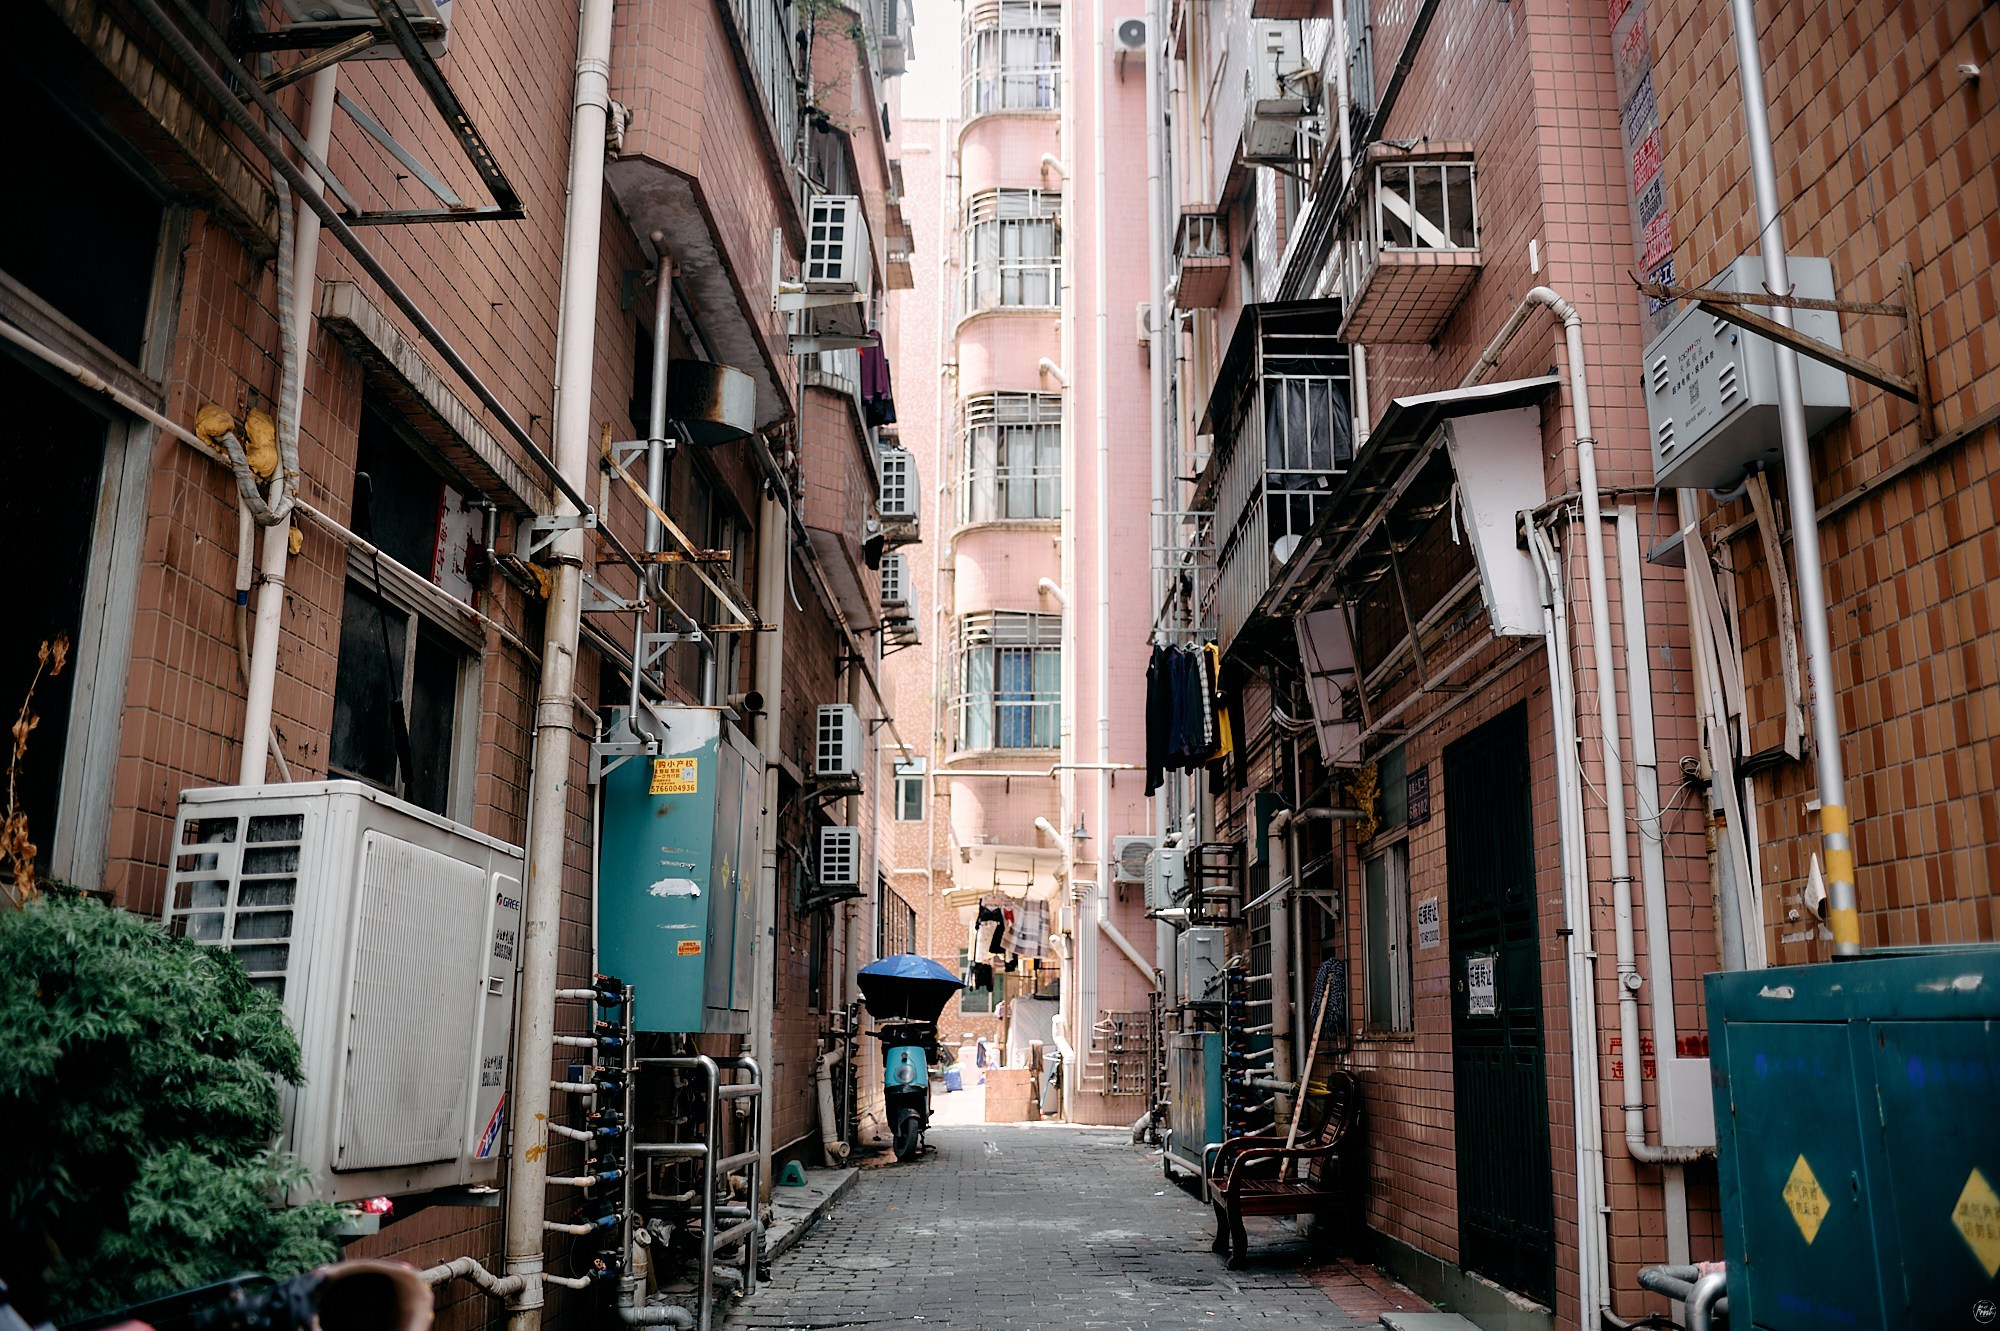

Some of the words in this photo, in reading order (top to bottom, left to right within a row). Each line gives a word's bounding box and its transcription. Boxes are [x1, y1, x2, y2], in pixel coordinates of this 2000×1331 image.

[1634, 128, 1659, 171] 白铁工程
[1640, 178, 1660, 216] 白铁工程
[503, 896, 520, 911] GREE
[1418, 903, 1438, 925] 旺铺转让
[1469, 963, 1492, 988] 旺铺转让
[1963, 1221, 2000, 1241] 切勿乱
